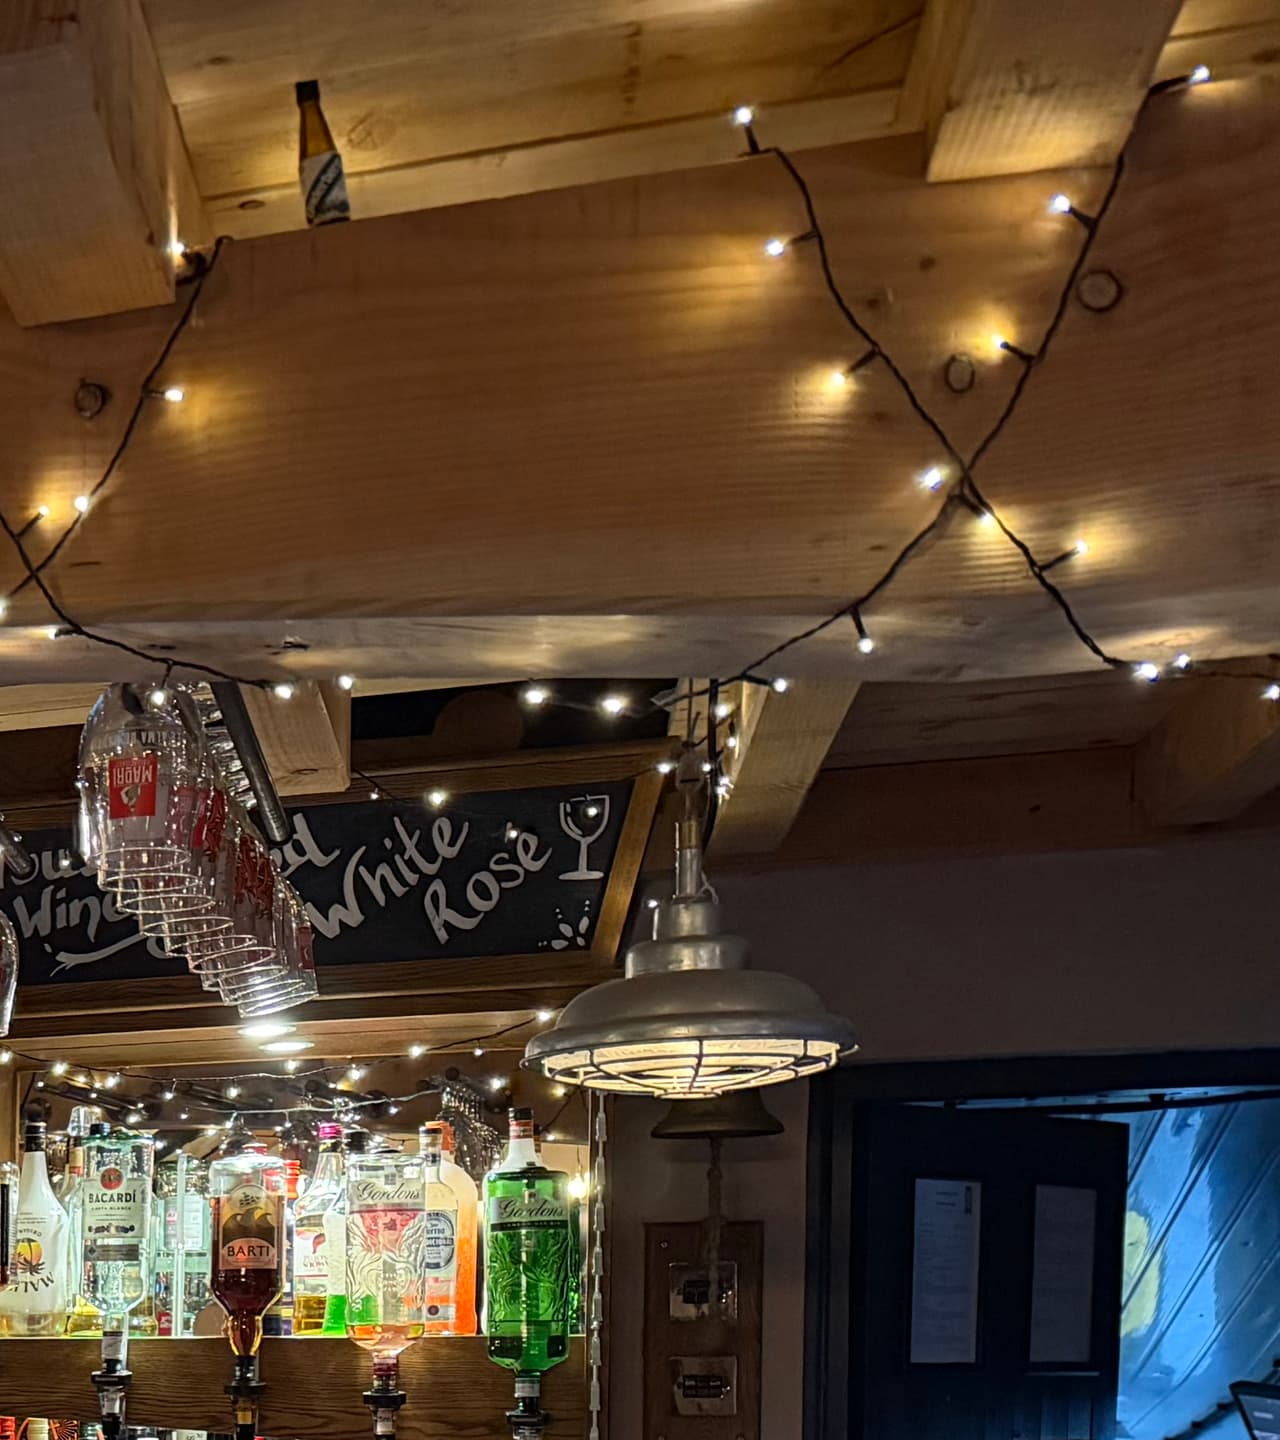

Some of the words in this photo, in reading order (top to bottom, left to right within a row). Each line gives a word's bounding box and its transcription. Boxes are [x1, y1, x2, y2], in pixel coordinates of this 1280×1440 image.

[308, 815, 470, 940] White
[423, 831, 552, 945] Rose
[89, 1190, 137, 1204] BACARDÍ
[227, 1245, 270, 1257] BARTI
